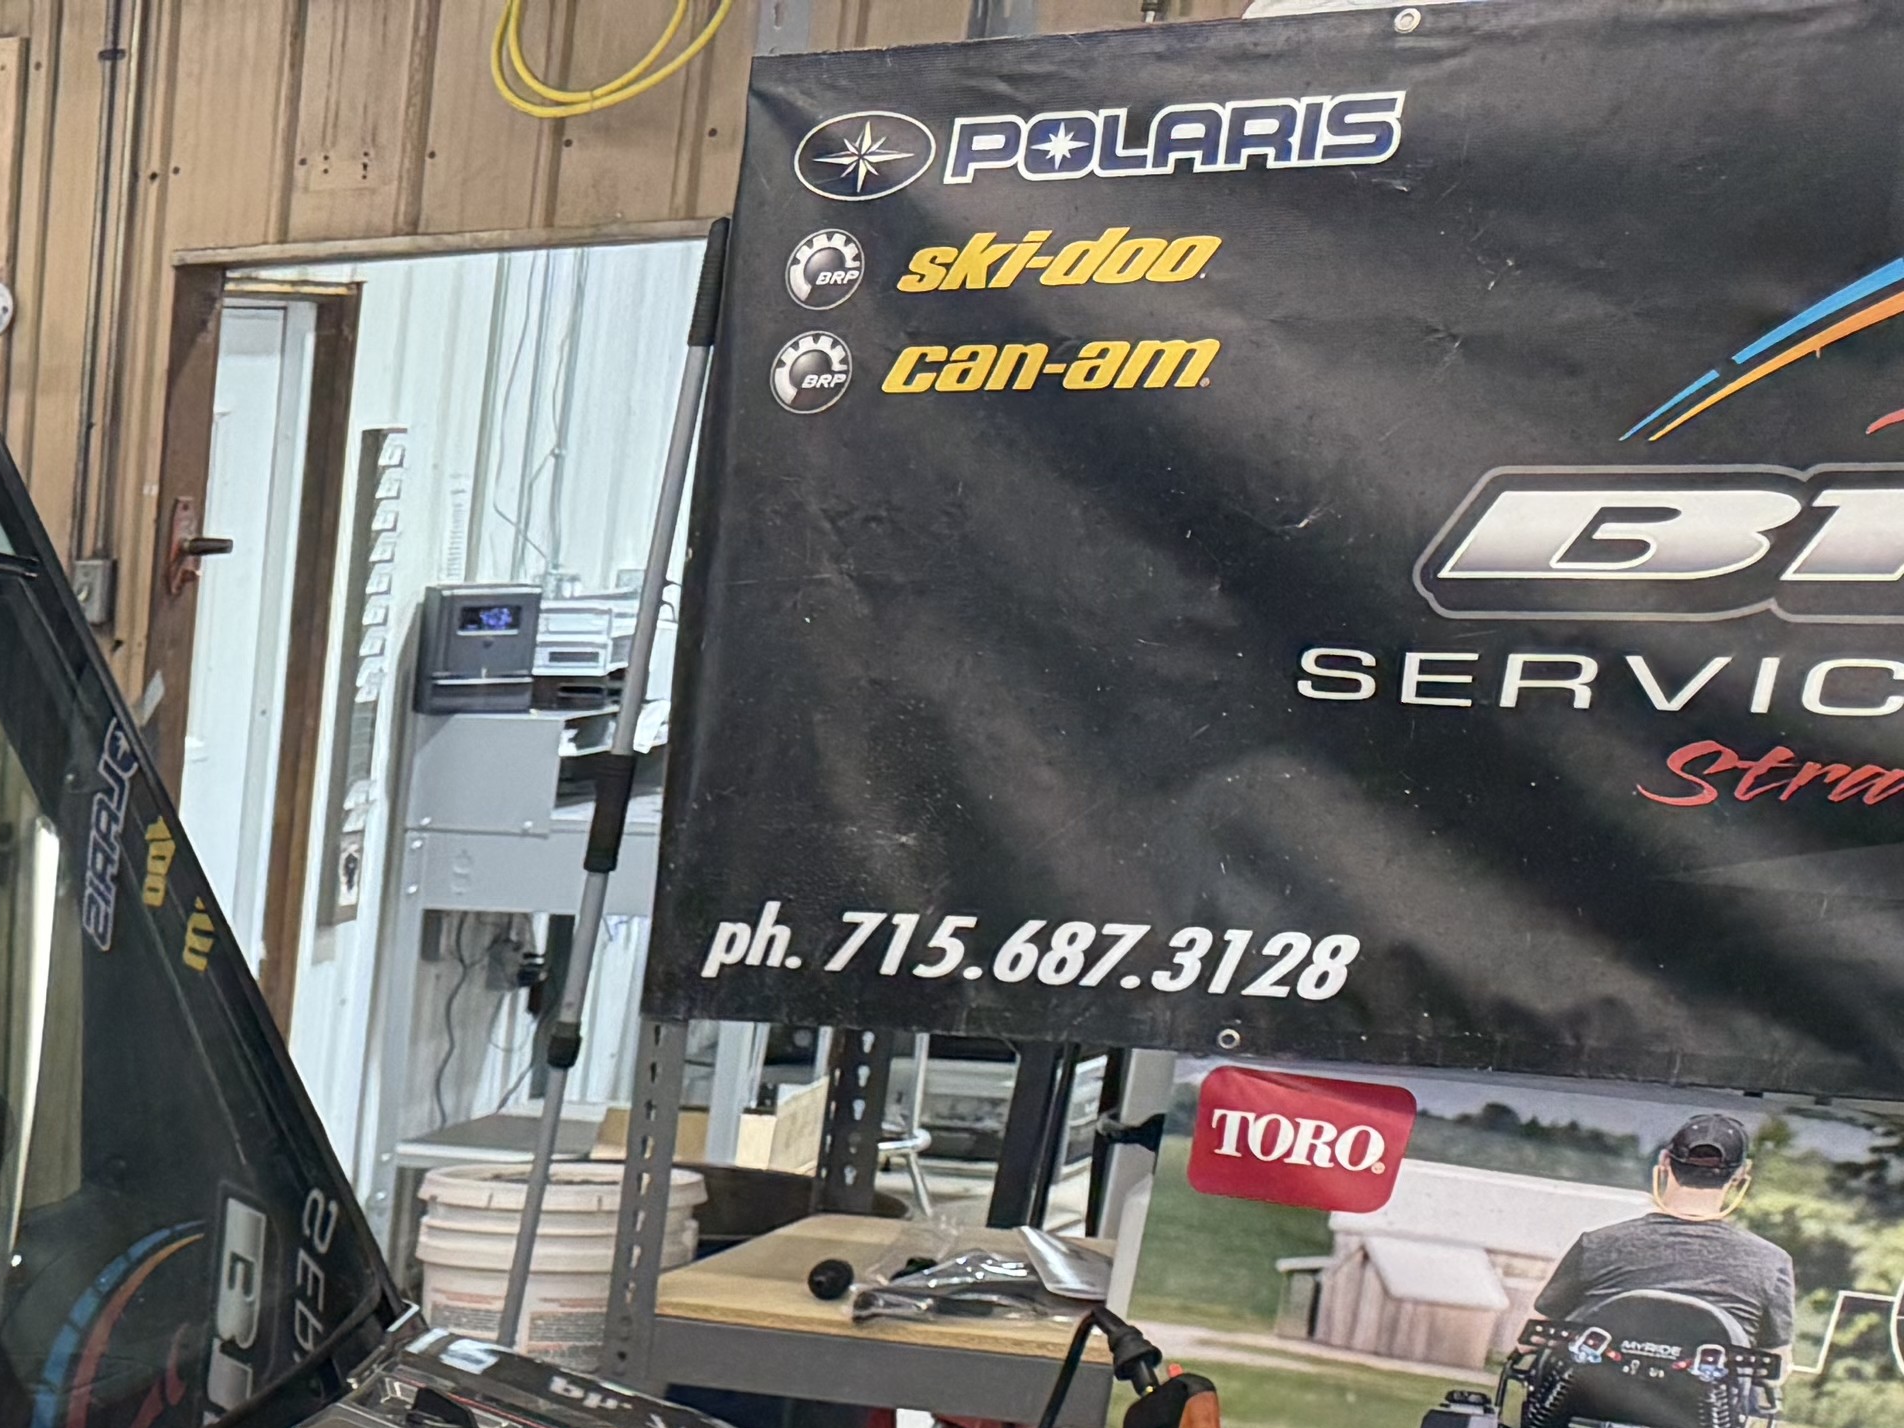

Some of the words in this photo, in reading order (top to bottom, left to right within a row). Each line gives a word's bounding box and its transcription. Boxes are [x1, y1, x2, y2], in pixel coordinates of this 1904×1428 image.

[944, 90, 1407, 186] POLARIS
[815, 270, 860, 286] BRP
[896, 227, 1222, 295] ski-doo
[802, 373, 847, 388] BRP
[882, 336, 1222, 395] can-am
[701, 900, 802, 978] ph.
[824, 909, 1361, 1002] 715.687.3128
[1210, 1107, 1386, 1175] TORO
